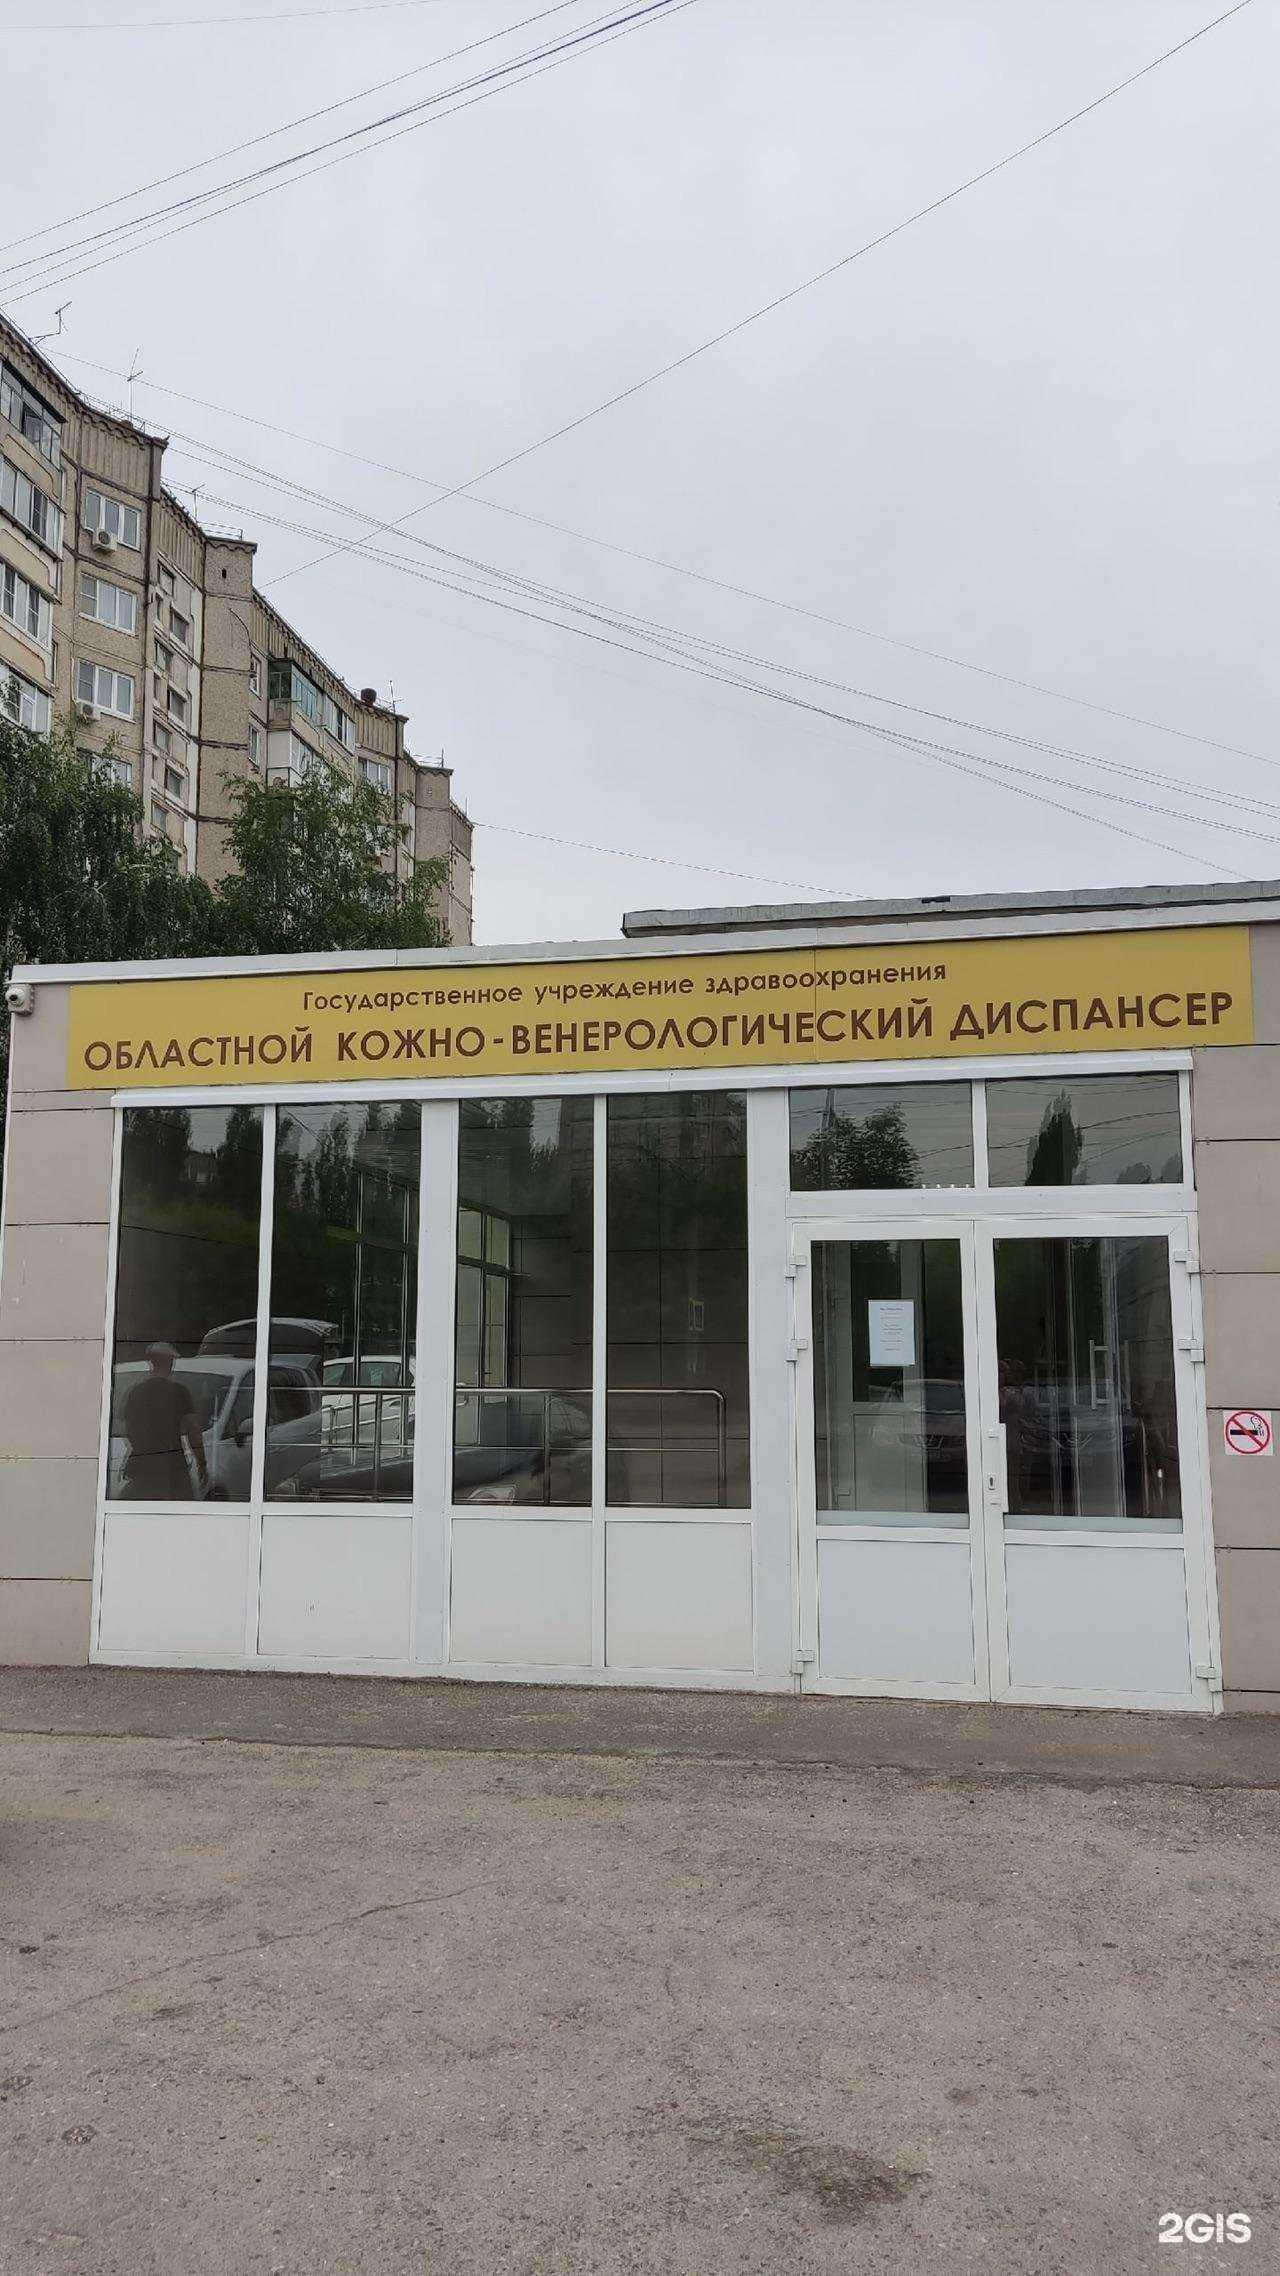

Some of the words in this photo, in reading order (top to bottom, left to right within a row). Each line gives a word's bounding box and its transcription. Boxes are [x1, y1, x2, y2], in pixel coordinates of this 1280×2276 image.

[302, 986, 524, 1015] Государственное
[533, 978, 695, 1006] учреждение
[704, 964, 947, 997] здравоохранения
[83, 1025, 313, 1072] ОБЛАСТНОЙ
[336, 997, 934, 1062] КОЖНО-ВЕНЕРОЛОГИЧЕСКИЙ
[948, 991, 1234, 1042] ДИСПАНСЕР
